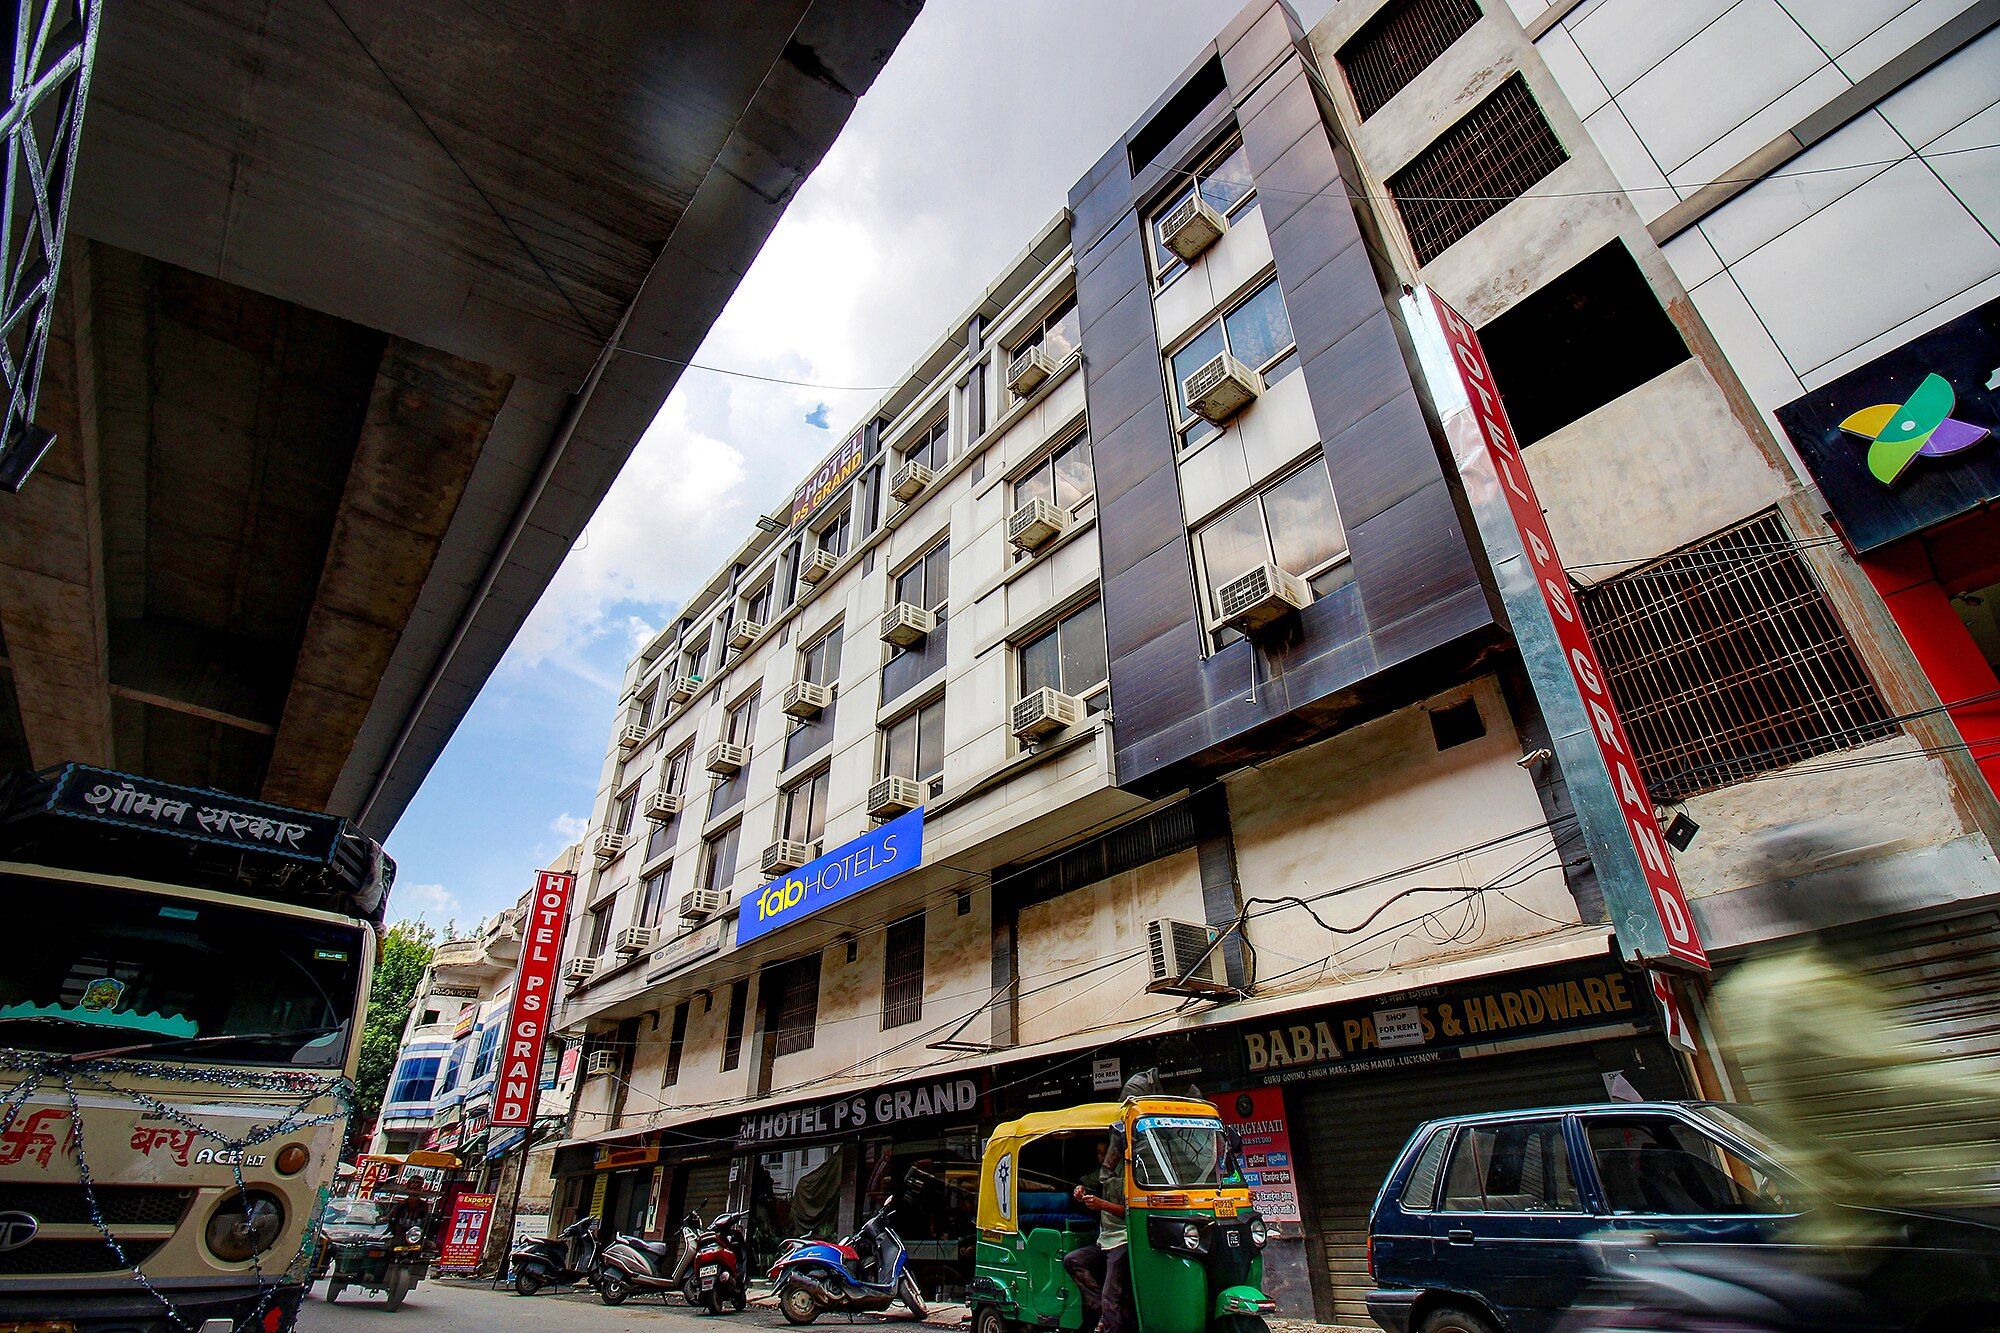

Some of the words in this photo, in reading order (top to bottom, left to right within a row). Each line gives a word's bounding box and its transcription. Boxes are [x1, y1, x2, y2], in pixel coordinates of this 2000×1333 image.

[792, 502, 809, 528] PS
[813, 452, 862, 507] GRAND
[805, 437, 862, 502] HOTEL
[1444, 308, 1529, 502] HOTEL
[1529, 538, 1572, 623] PS
[1571, 646, 1691, 944] GRAND
[197, 804, 313, 850] सरकार
[533, 876, 564, 961] HOTEL
[523, 976, 544, 1011] PS
[1245, 1021, 1342, 1070] BABA
[1438, 1003, 1464, 1037] &
[1463, 973, 1633, 1034] HARDWARE
[1385, 1012, 1407, 1021] SHOP
[1379, 1025, 1395, 1033] FOR
[1396, 1022, 1418, 1031] RENT
[502, 1021, 537, 1121] GRAND
[759, 1105, 828, 1140] HOTEL
[834, 1098, 867, 1129] PS
[875, 1079, 977, 1122] GRAND
